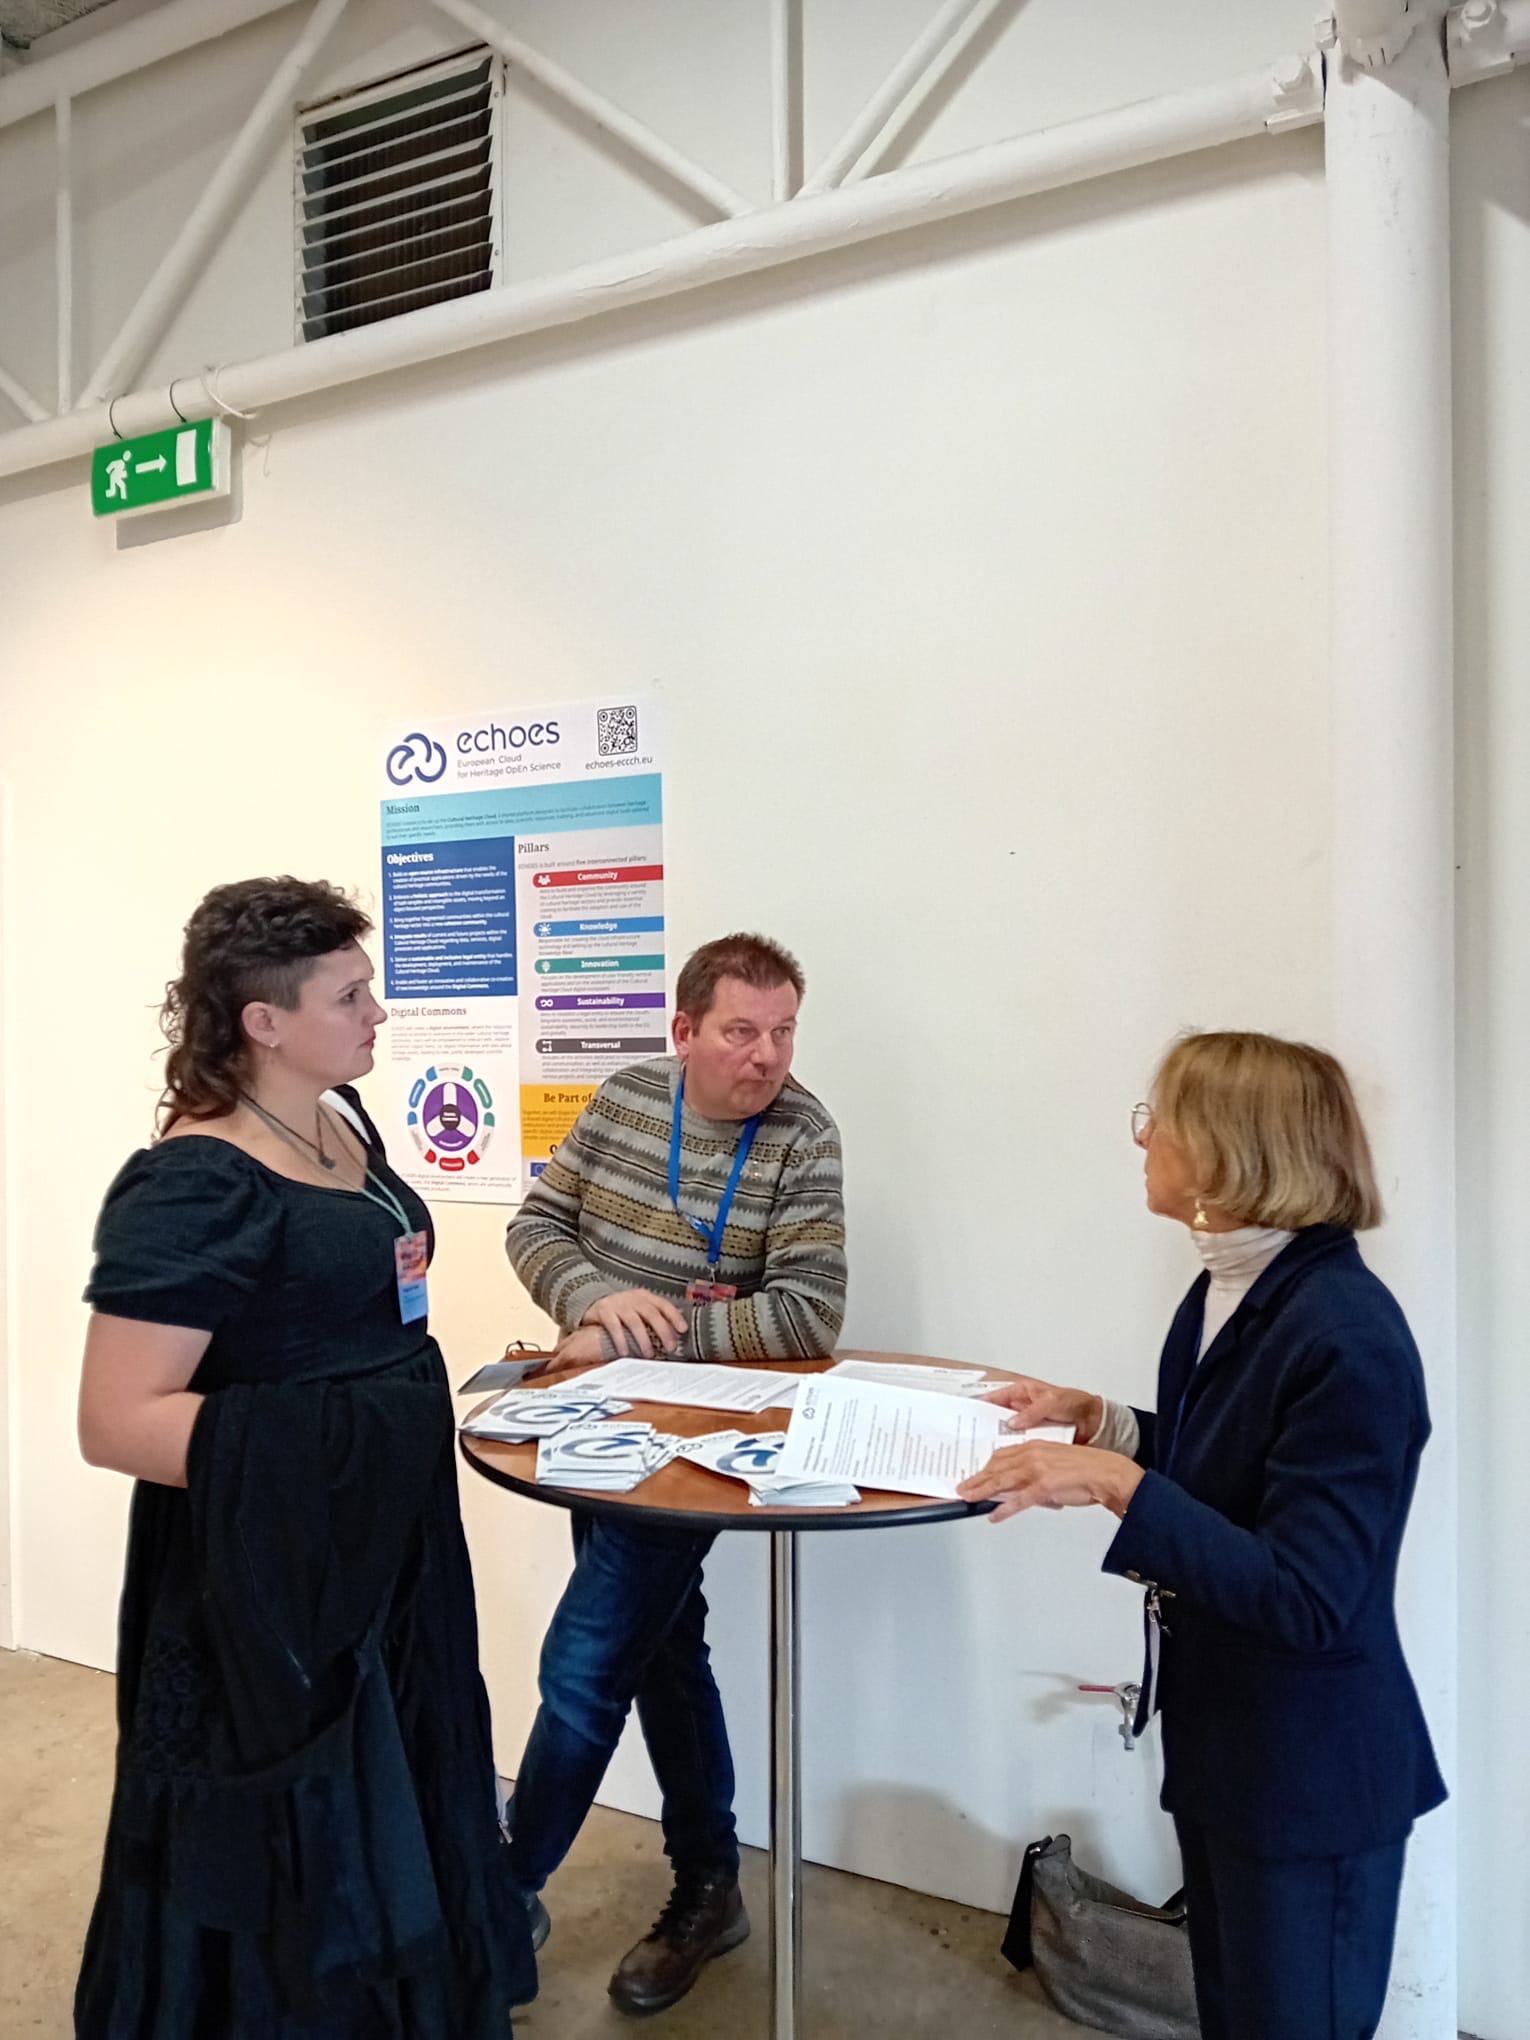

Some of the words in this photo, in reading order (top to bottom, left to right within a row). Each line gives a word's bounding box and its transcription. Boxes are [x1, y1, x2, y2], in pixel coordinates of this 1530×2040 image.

[456, 721, 560, 754] echoes
[457, 757, 495, 768] European
[498, 754, 522, 764] Cloud
[585, 756, 653, 770] echoes-eccch.eu
[470, 767, 503, 777] Heritage
[505, 765, 528, 775] OpEn
[530, 761, 561, 772] Science
[386, 803, 420, 815] Mission
[518, 842, 549, 854] Pillars
[387, 852, 434, 865] Objectives
[577, 871, 618, 881] Community
[579, 922, 618, 931] Knowledge
[581, 960, 619, 968] Innovation
[577, 997, 625, 1006] Sustainability
[391, 1006, 419, 1019] Digital
[421, 1007, 467, 1016] Commons
[581, 1041, 621, 1049] Transversal
[543, 1093, 556, 1103] Be
[558, 1093, 579, 1103] Part
[581, 1093, 593, 1103] of
